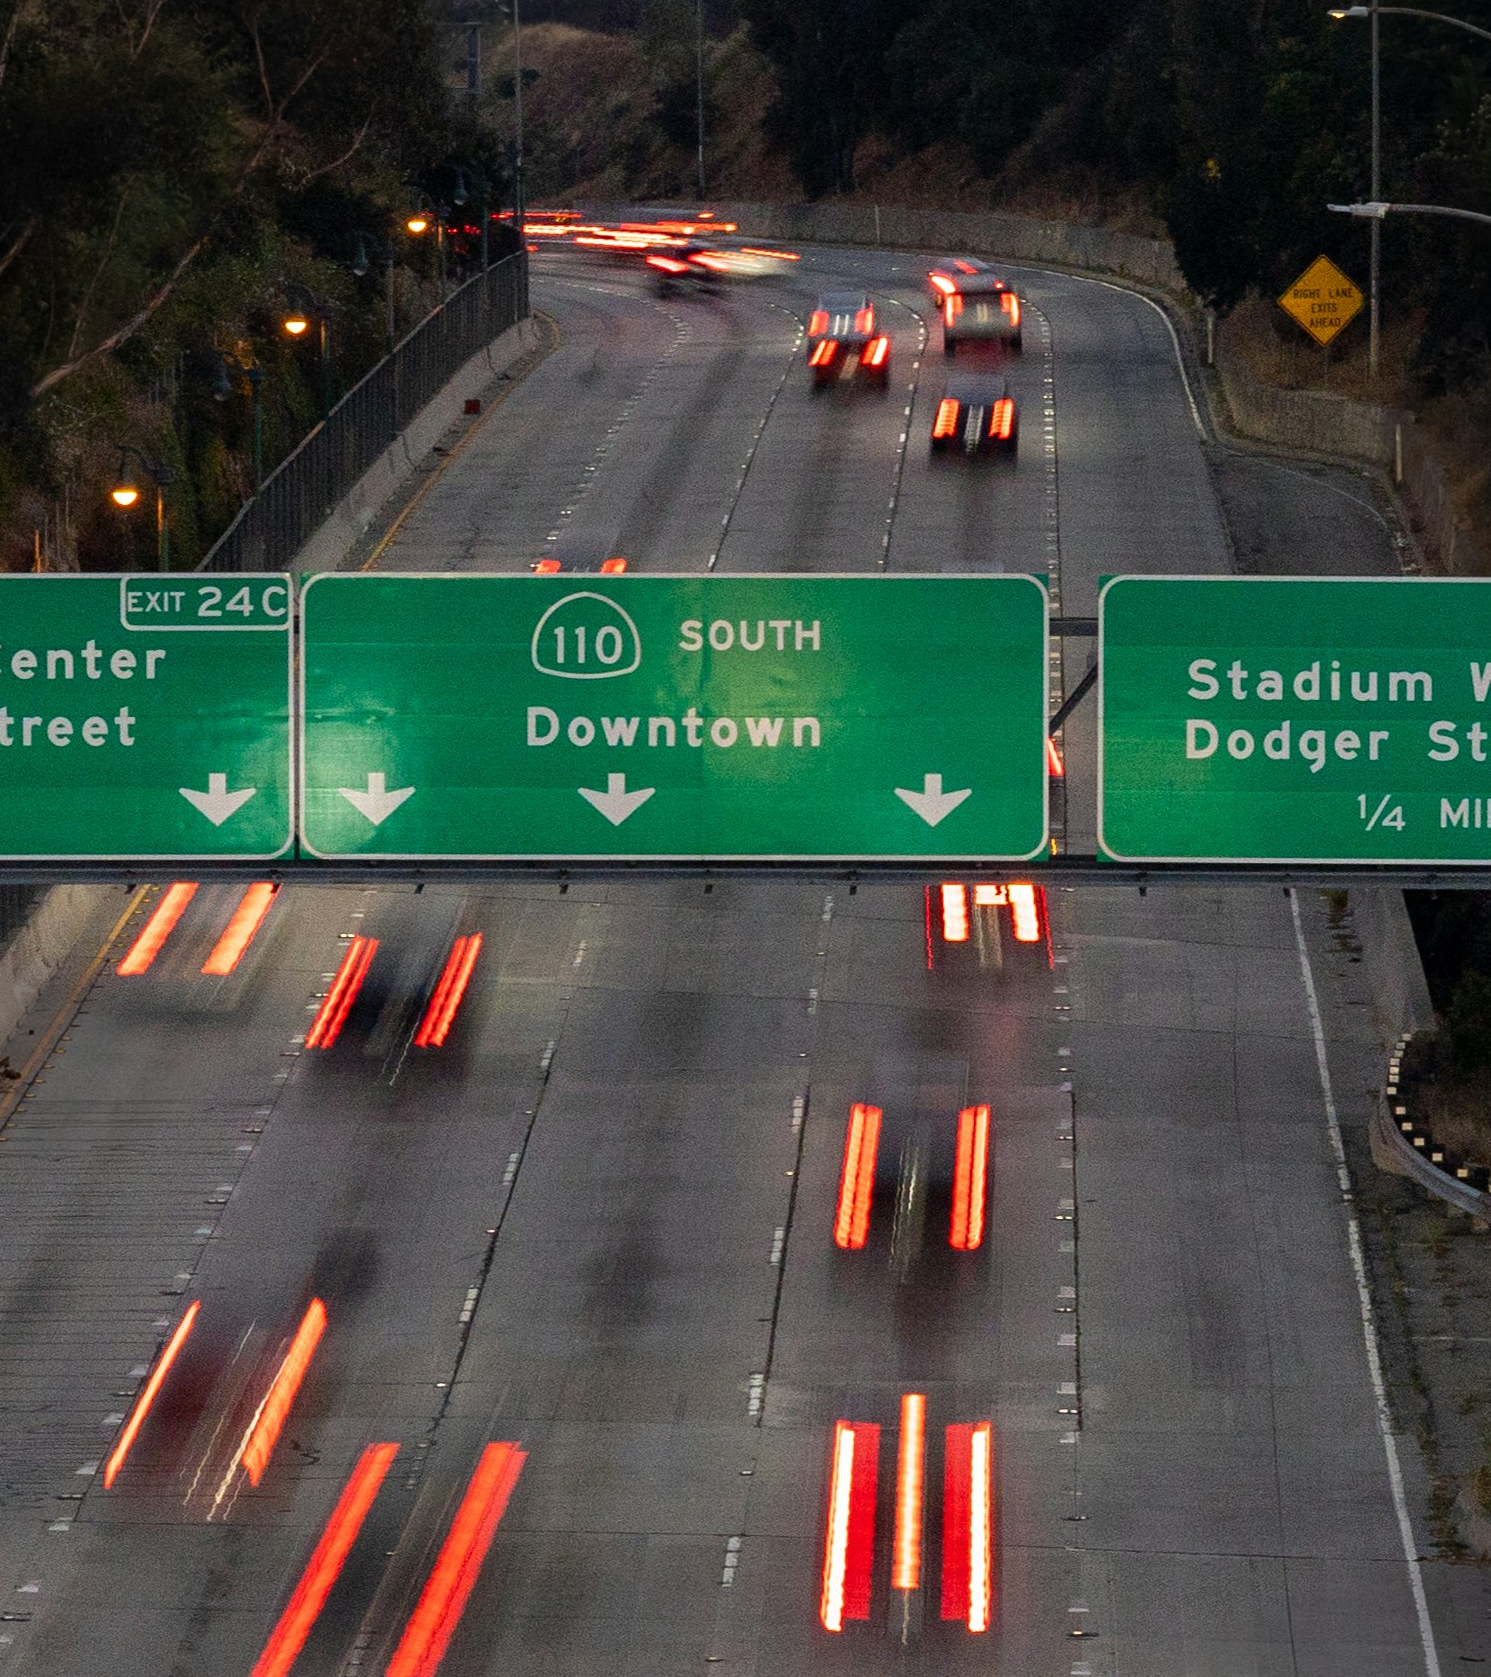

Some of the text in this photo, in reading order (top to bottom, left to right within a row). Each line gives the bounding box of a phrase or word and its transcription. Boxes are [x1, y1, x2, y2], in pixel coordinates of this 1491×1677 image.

[124, 588, 186, 617] EXIT
[554, 619, 821, 665] 110 SOUTH
[1187, 658, 1433, 702] Stadium
[527, 706, 821, 748] Downtown
[1185, 718, 1389, 774] Dodger
